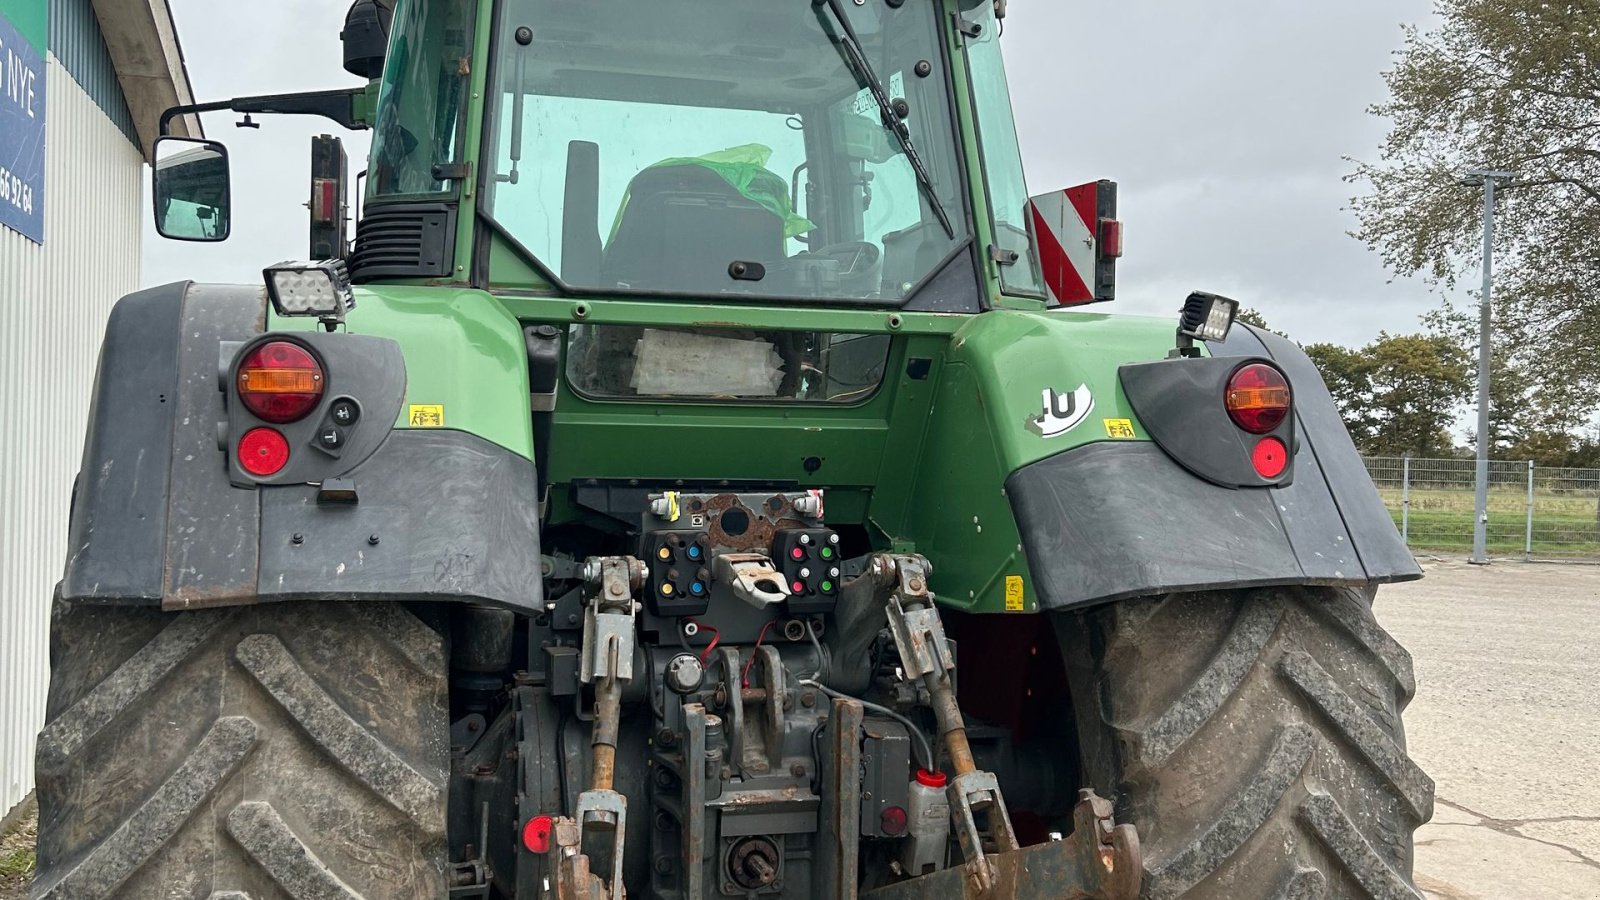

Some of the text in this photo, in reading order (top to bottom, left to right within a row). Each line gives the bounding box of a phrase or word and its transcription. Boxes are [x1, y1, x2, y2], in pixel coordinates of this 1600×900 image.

[8, 47, 35, 118] NYE
[12, 175, 21, 209] 92
[23, 183, 32, 216] 64
